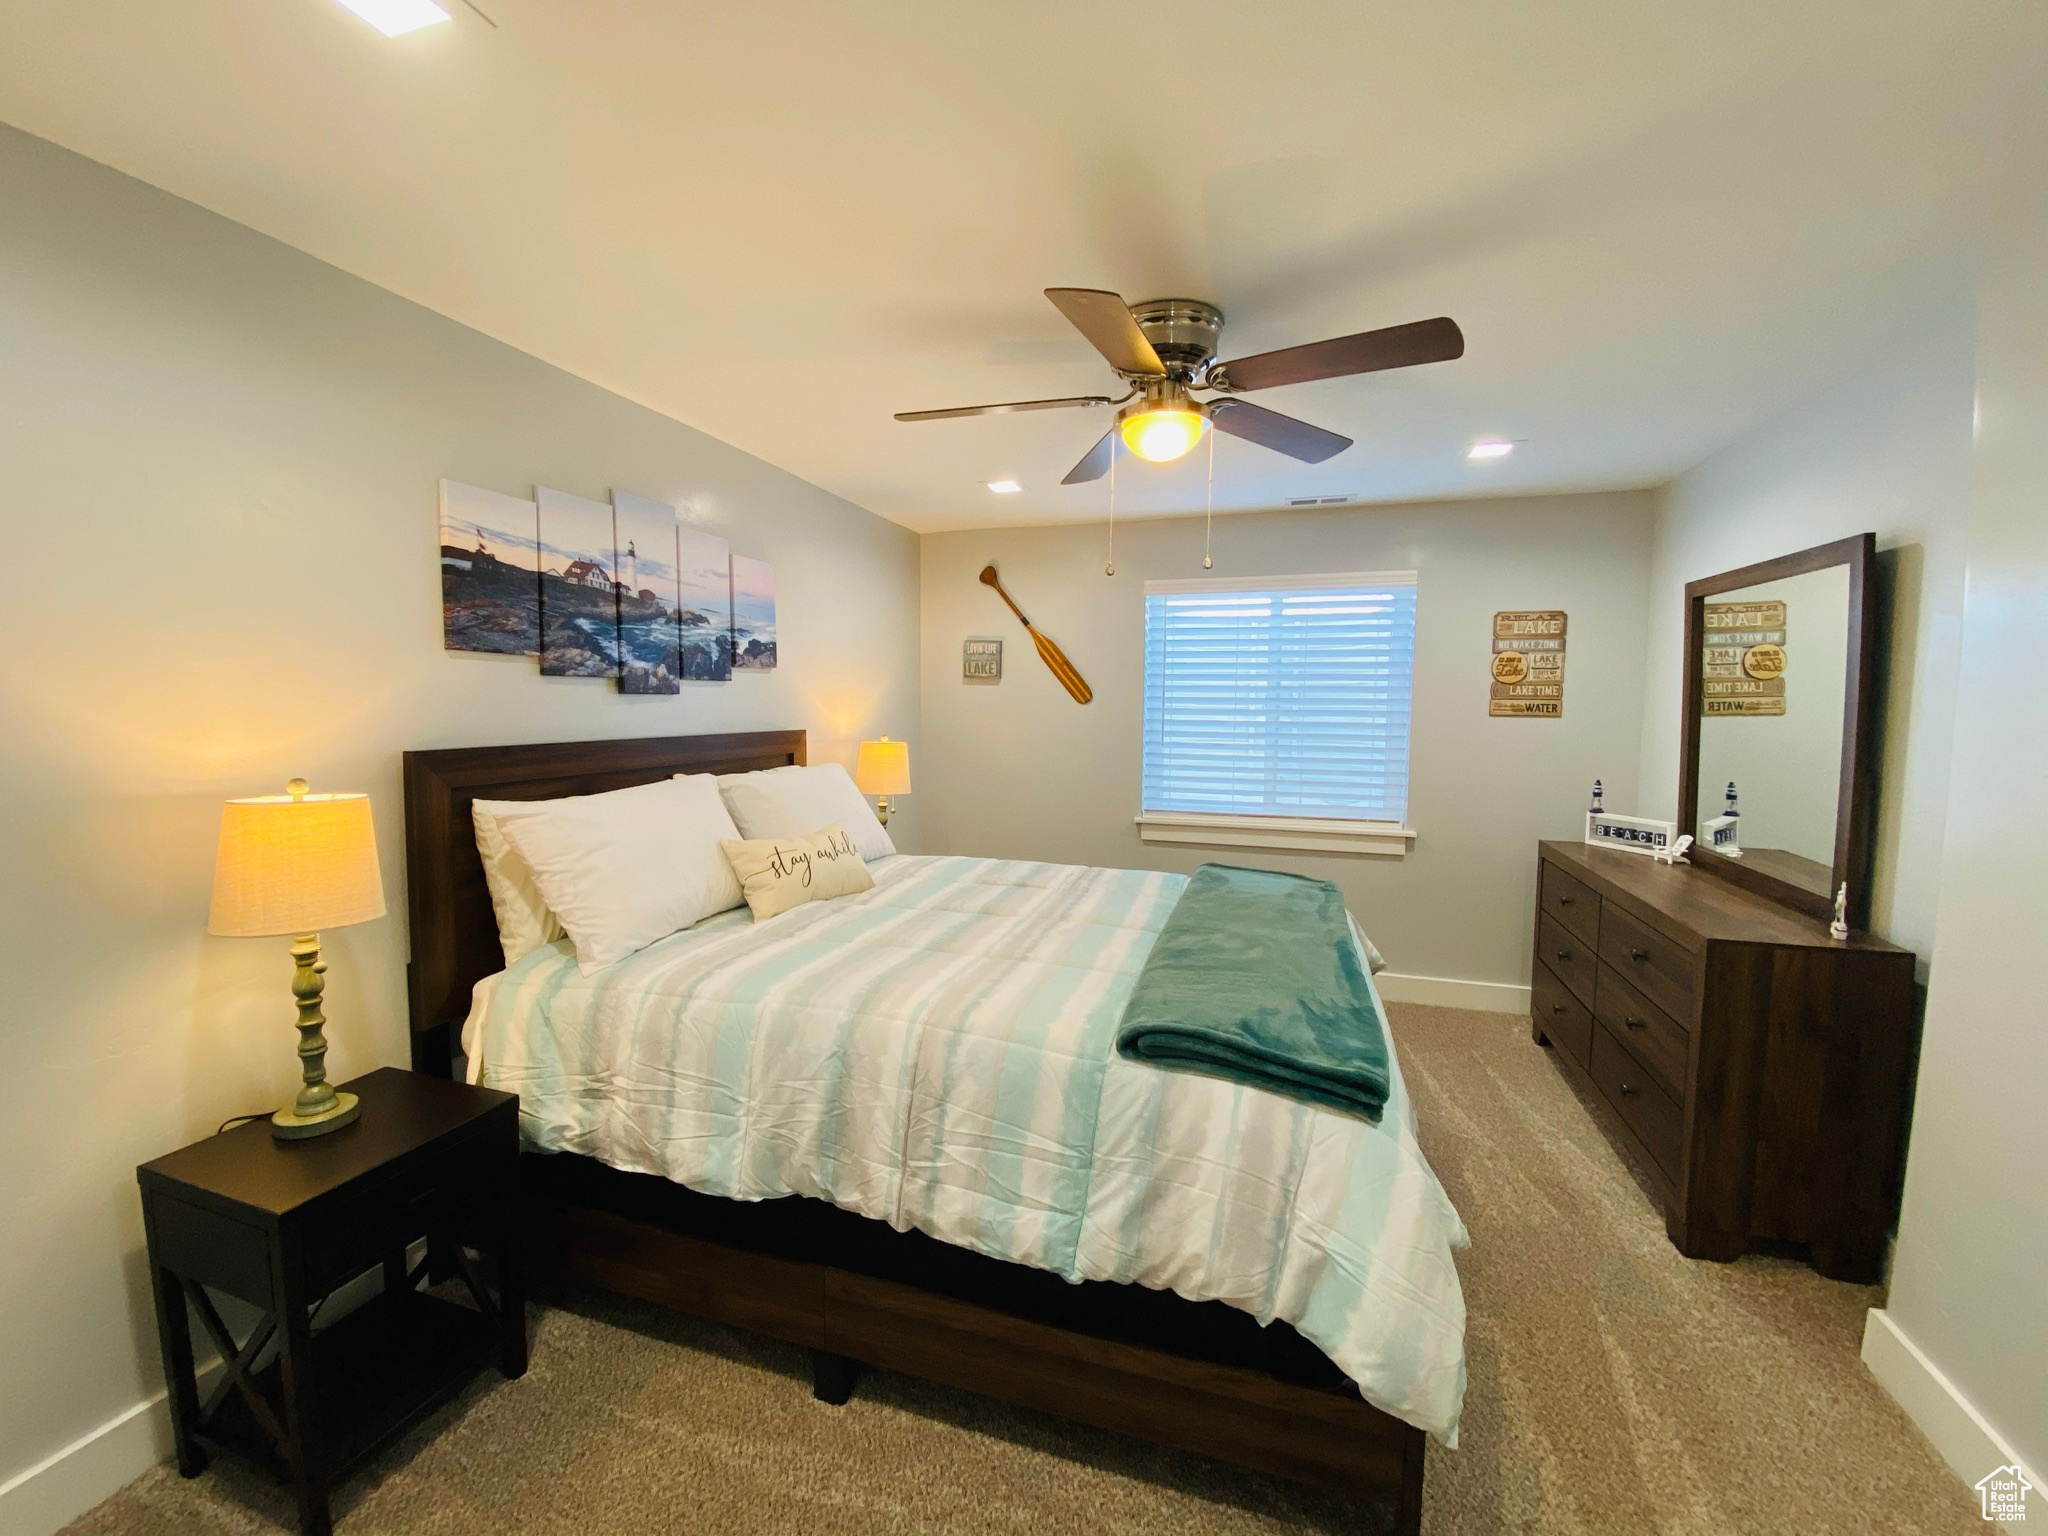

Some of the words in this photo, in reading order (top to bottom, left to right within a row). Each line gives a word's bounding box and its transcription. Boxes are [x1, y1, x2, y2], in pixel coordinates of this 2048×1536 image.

[1513, 621, 1561, 633] LAKE
[985, 643, 997, 654] LIFE
[1498, 640, 1510, 649] NO
[1512, 640, 1535, 649] WAKE
[1538, 640, 1559, 649] ZONE
[1533, 655, 1558, 663] LAKE
[968, 662, 994, 674] LAKE
[1496, 663, 1524, 677] Lake
[1509, 685, 1535, 696] LAKE
[1536, 686, 1559, 696] TIME
[1525, 703, 1558, 713] WATER
[1597, 826, 1666, 846] BEACH
[745, 846, 812, 888] stay
